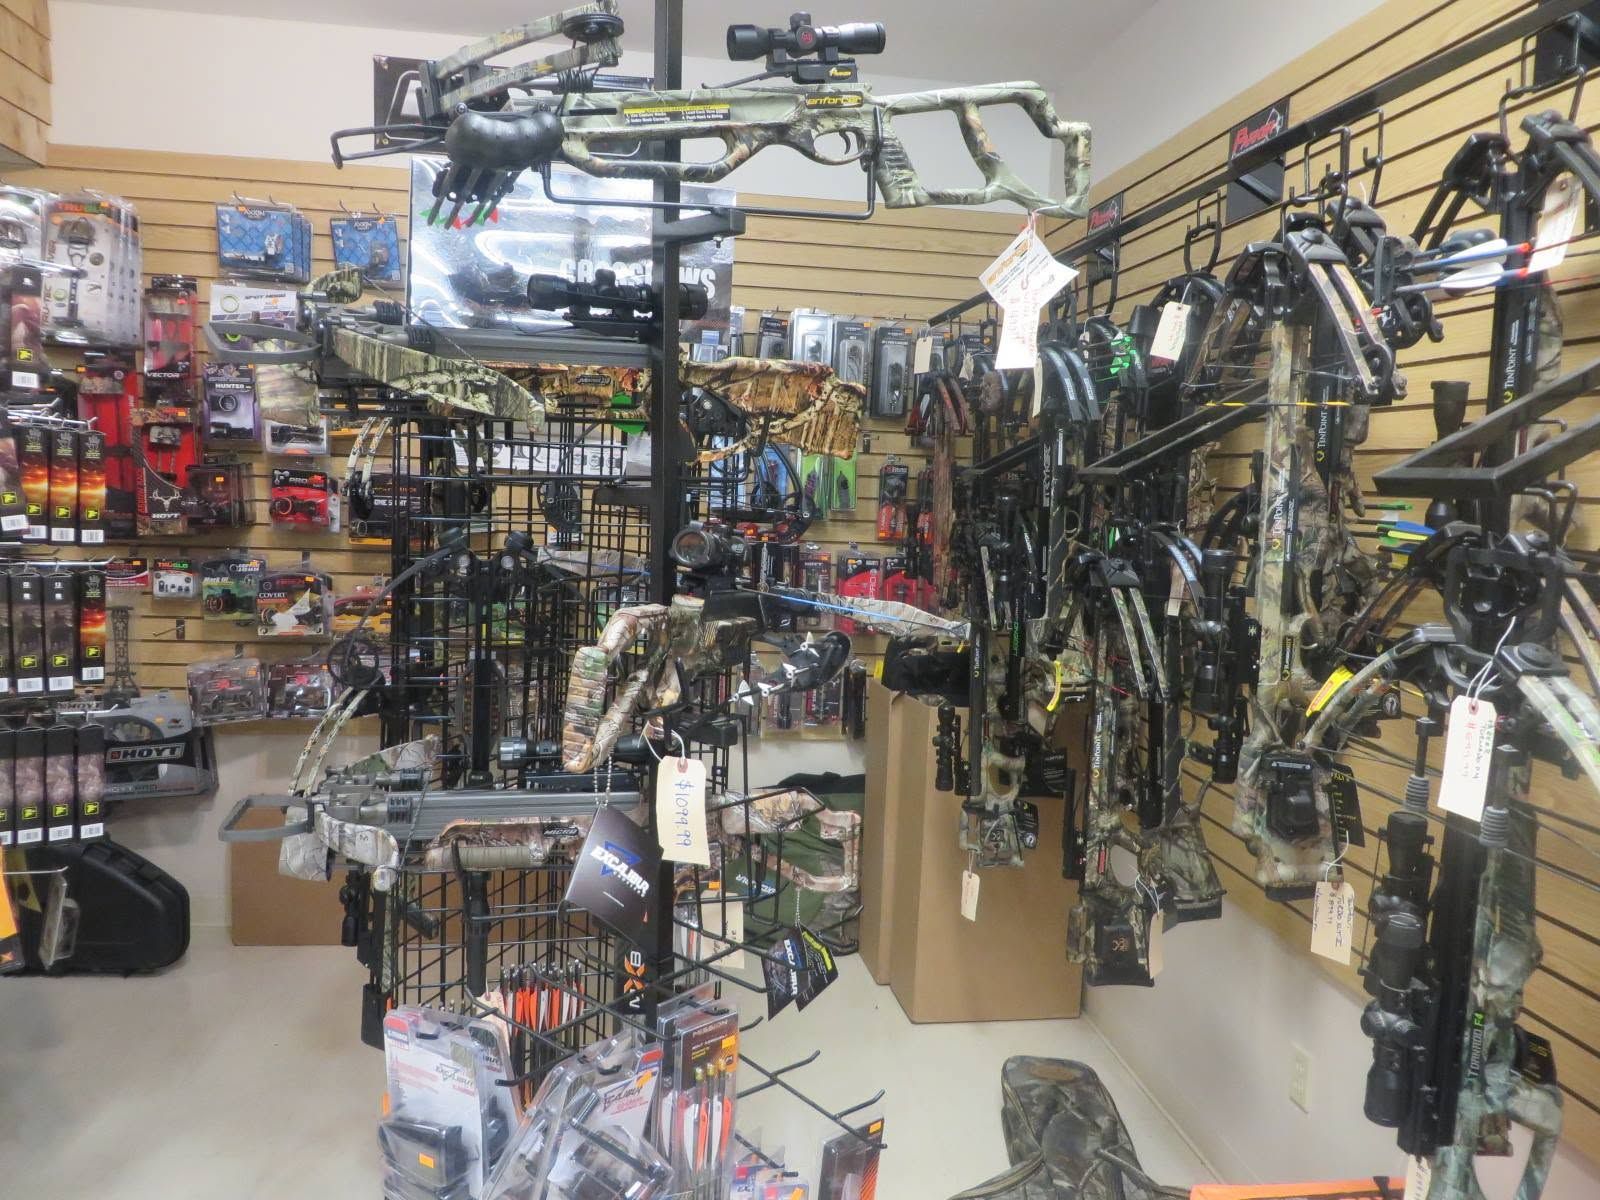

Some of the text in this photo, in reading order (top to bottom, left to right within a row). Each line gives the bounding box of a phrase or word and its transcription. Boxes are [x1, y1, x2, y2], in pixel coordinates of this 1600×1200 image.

[289, 477, 308, 485] PRO
[158, 561, 189, 569] TRUGLO
[123, 746, 181, 758] HOYT
[591, 845, 649, 894] EXCALIBUR
[1467, 1012, 1485, 1077] TORNADO F4
